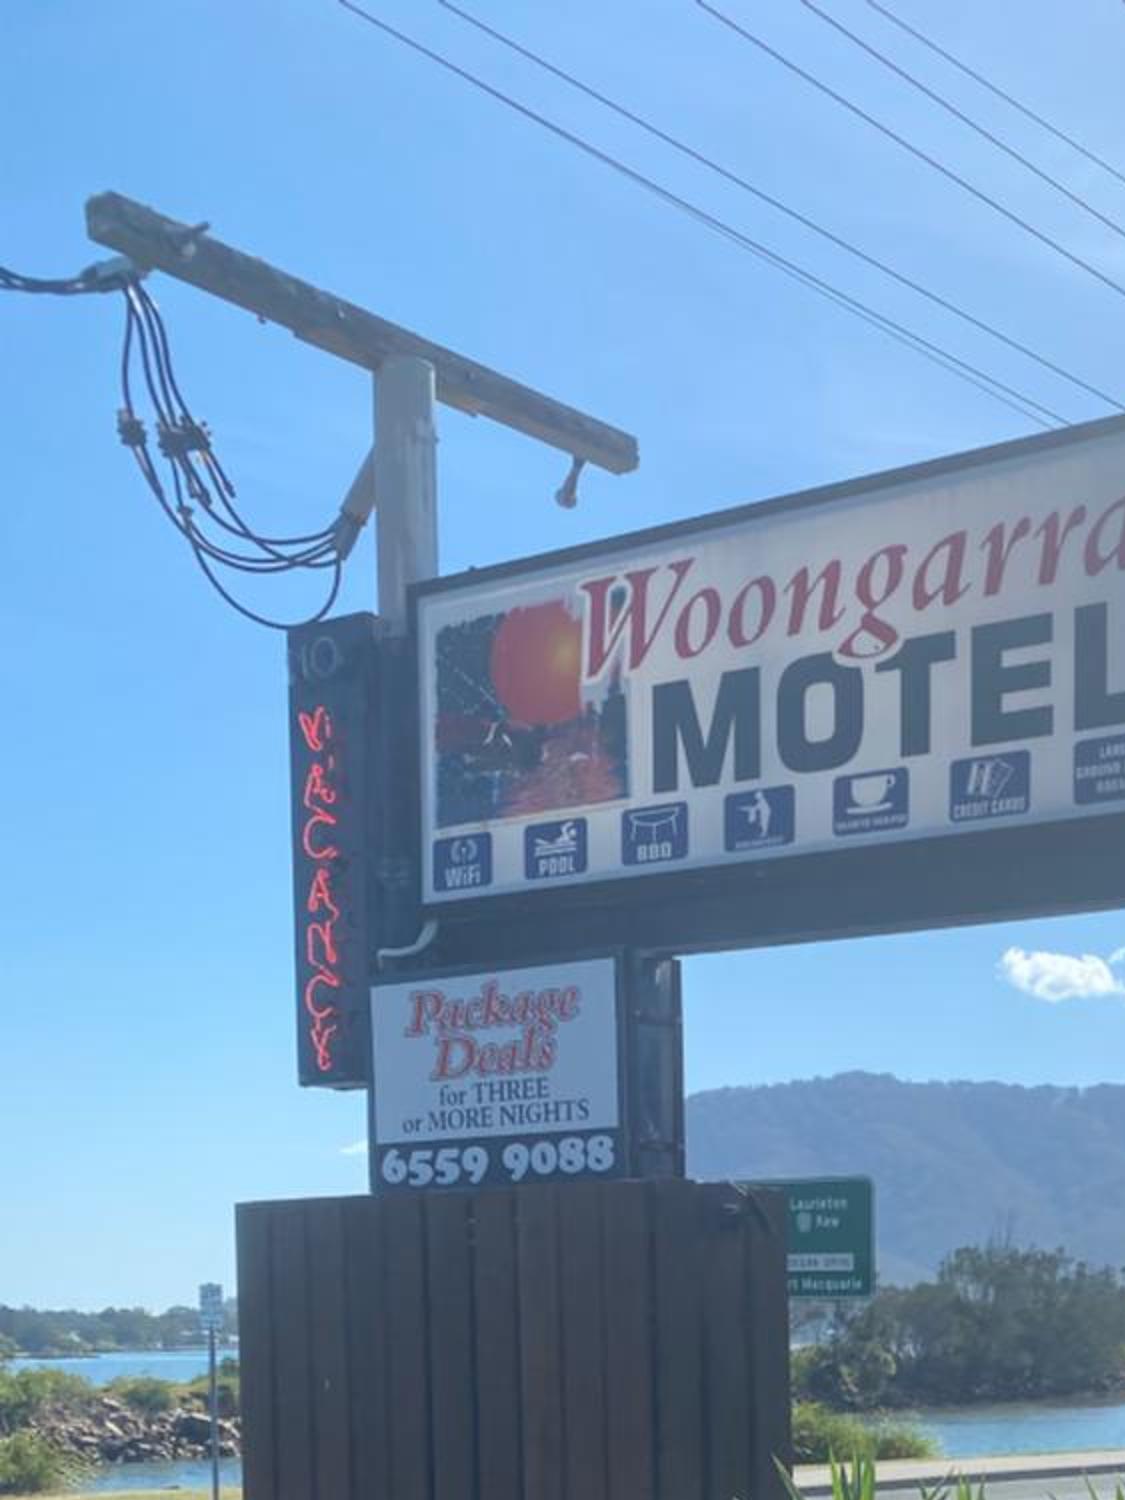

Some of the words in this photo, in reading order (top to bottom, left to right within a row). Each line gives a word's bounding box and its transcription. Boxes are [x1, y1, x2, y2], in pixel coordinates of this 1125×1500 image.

[953, 801, 990, 819] CREDIT
[991, 796, 1026, 815] CARDS
[445, 865, 482, 888] WiFi
[538, 855, 576, 876] POOL
[404, 979, 582, 1039] Package
[430, 1024, 559, 1082] Deals
[439, 1084, 467, 1106] for
[474, 1077, 550, 1104] THREE
[402, 1117, 423, 1134] or
[427, 1104, 494, 1133] MORE
[499, 1098, 591, 1127] NIGHTS
[381, 1145, 490, 1186] 6559
[501, 1134, 615, 1181] 9088
[789, 1196, 848, 1211] Laurieton
